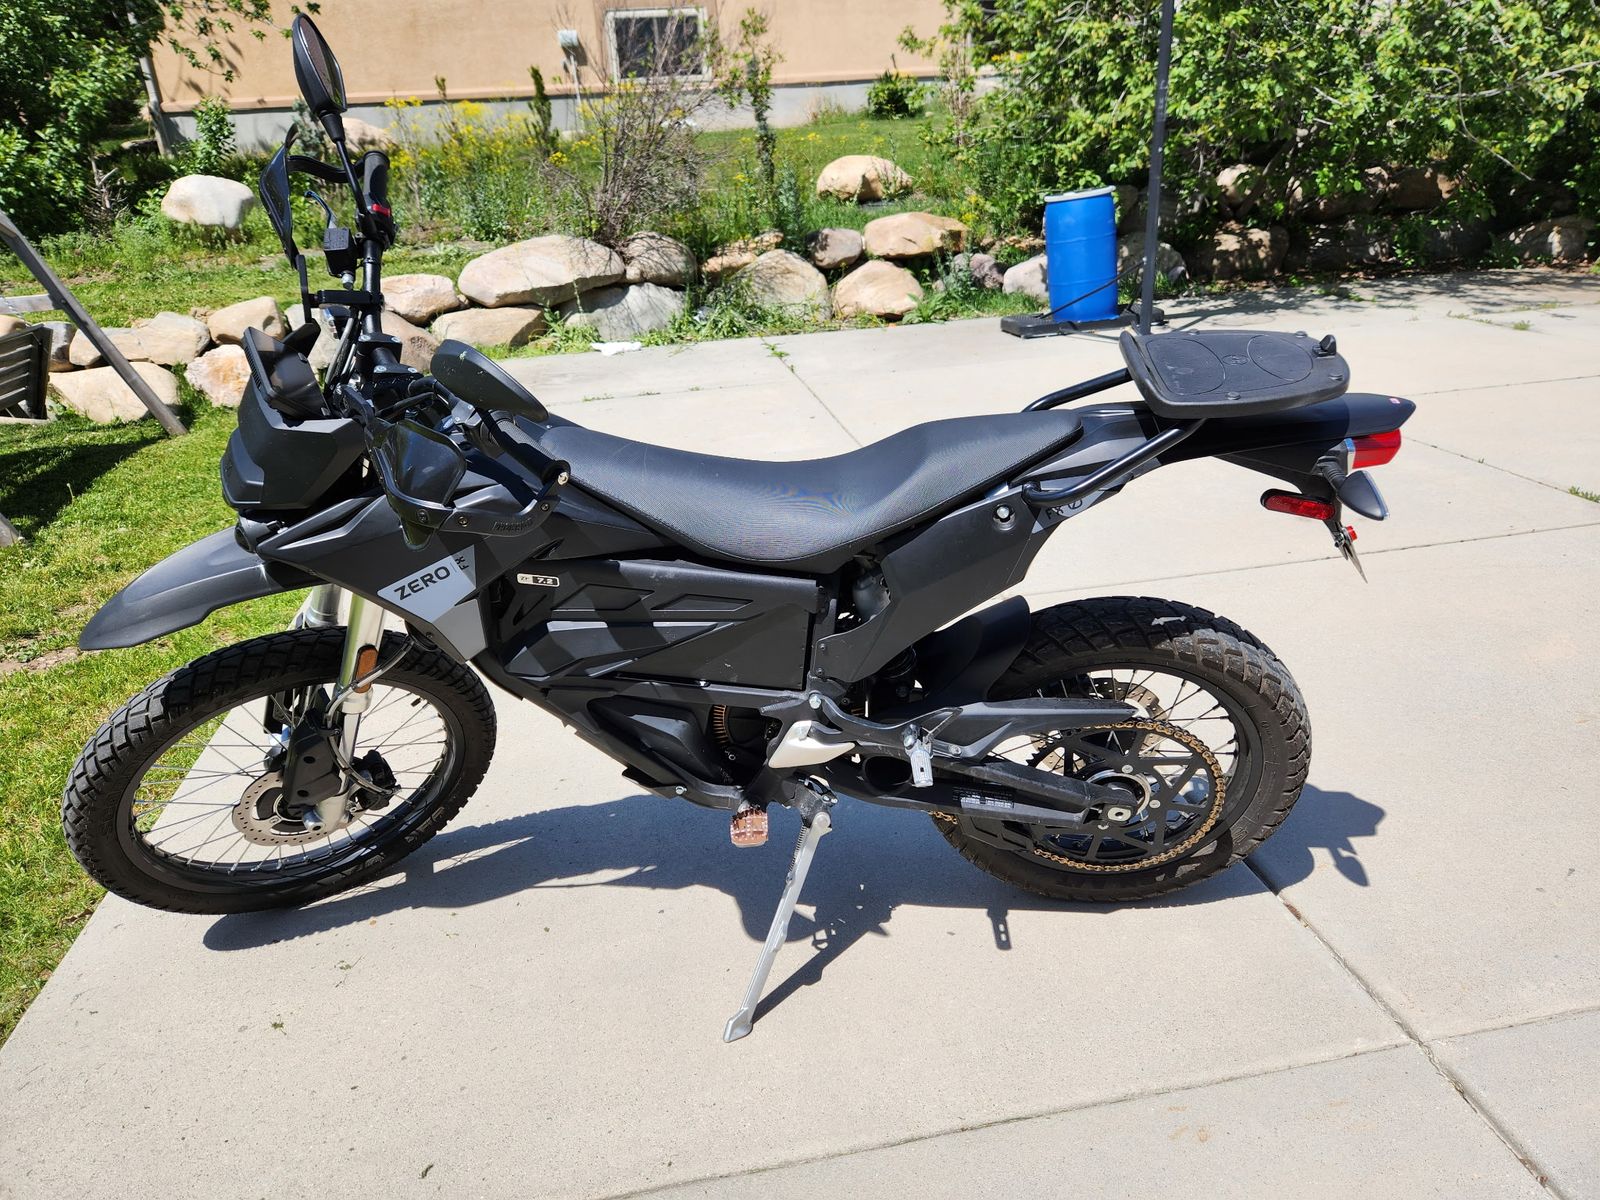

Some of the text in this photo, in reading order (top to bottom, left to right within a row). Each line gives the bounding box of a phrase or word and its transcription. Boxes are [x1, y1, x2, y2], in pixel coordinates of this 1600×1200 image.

[455, 555, 470, 571] FX
[393, 566, 451, 601] ZERO
[537, 577, 554, 585] 7.2
